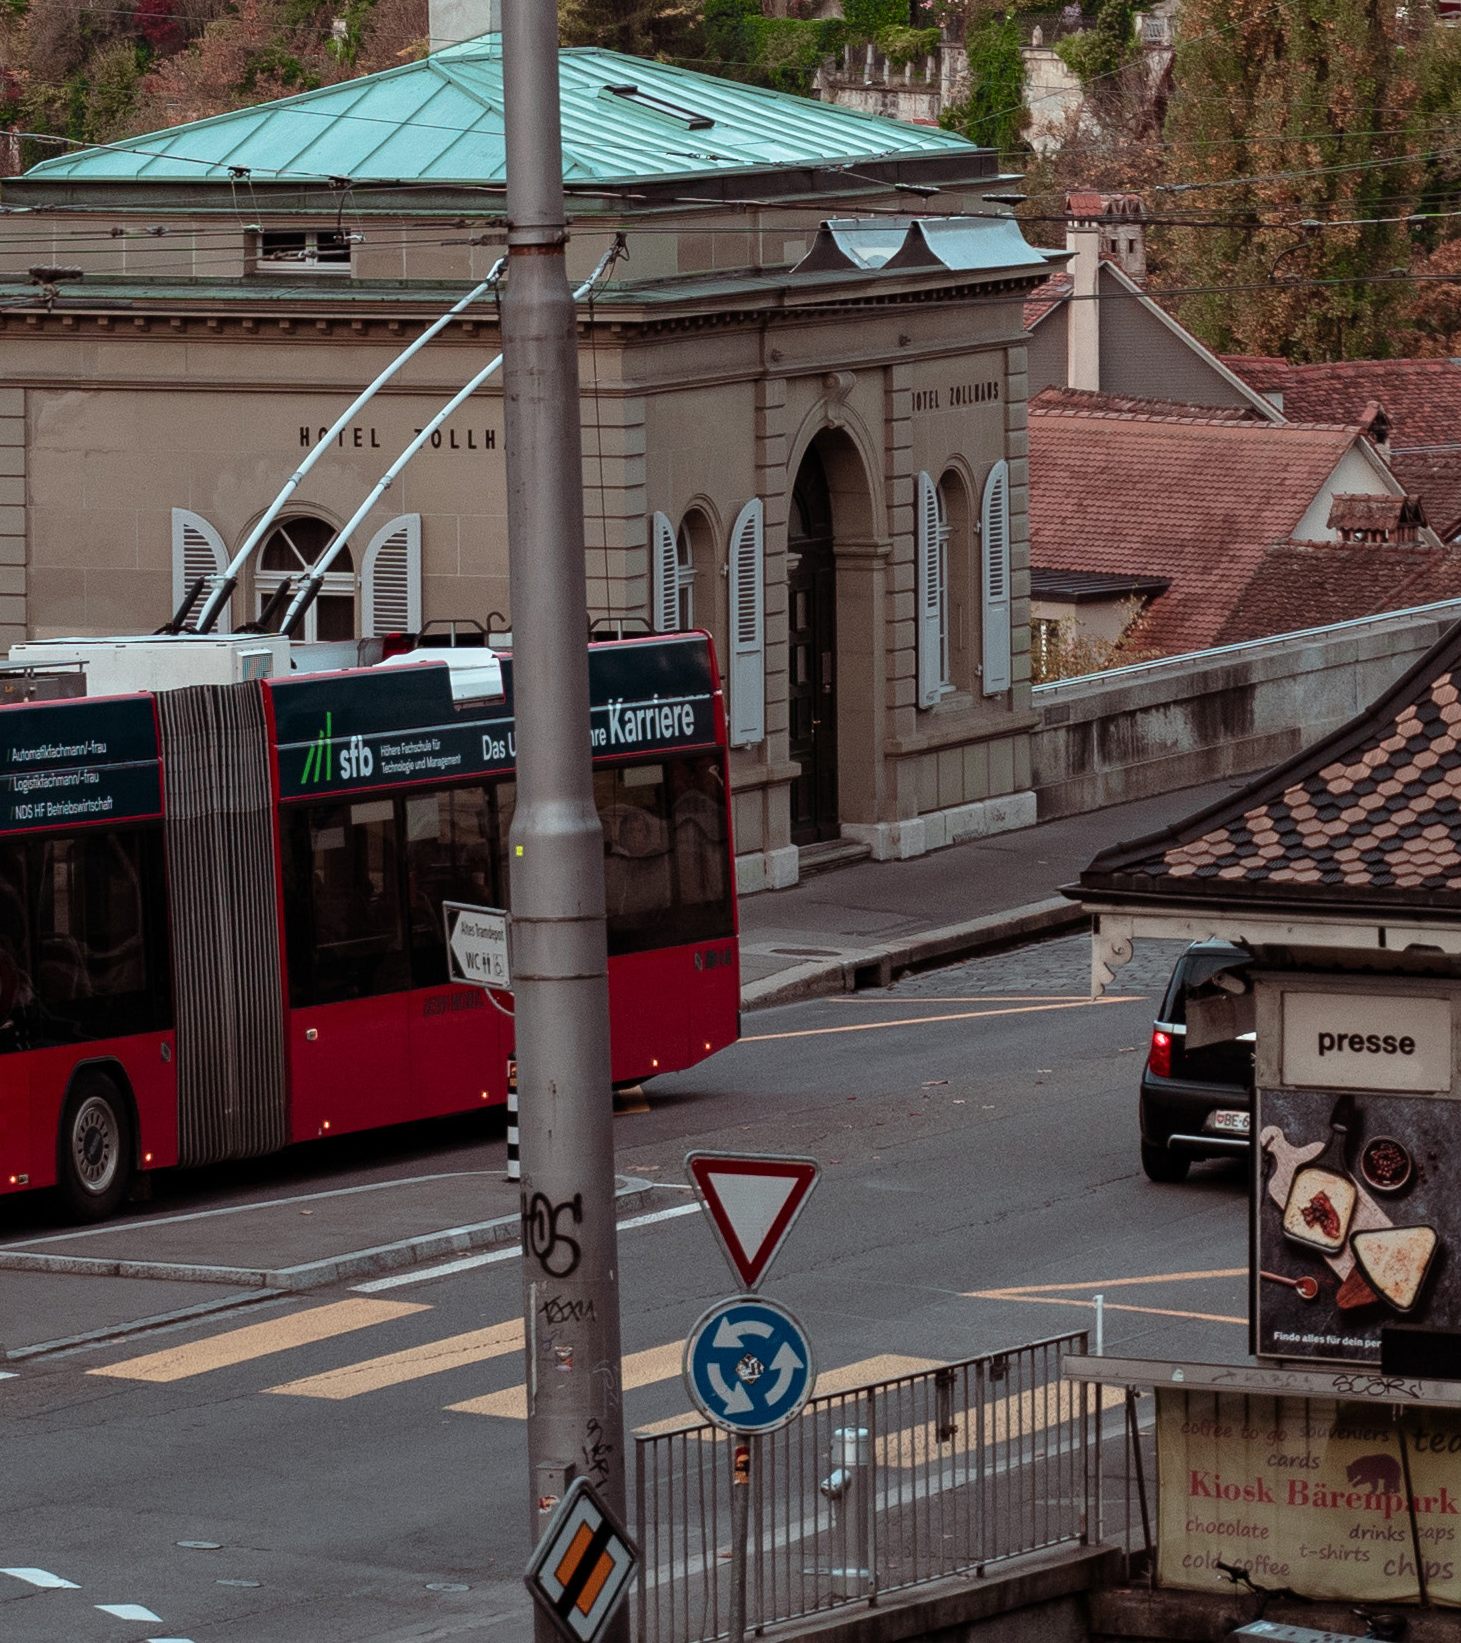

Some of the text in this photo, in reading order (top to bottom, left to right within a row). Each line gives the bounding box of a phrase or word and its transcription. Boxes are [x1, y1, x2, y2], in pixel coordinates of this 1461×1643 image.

[950, 381, 998, 406] ZOLLHAUS
[414, 428, 507, 449] ZOLLH
[608, 693, 695, 746] Karriere
[340, 735, 374, 780] sfb
[482, 734, 506, 761] Das
[415, 758, 426, 770] und
[15, 804, 34, 820] NDS
[34, 802, 46, 817] HF
[465, 951, 480, 971] WC
[1318, 1030, 1416, 1056] presse
[1273, 1331, 1301, 1343] Finde
[1301, 1332, 1325, 1344] alles
[1326, 1334, 1342, 1345] für
[1342, 1336, 1363, 1347] dein
[1181, 1420, 1233, 1439] coffee
[1240, 1425, 1259, 1441] to
[1266, 1427, 1288, 1447] go
[1267, 1451, 1321, 1471] cards
[1189, 1468, 1276, 1504] Kiosk
[1185, 1516, 1271, 1540] chocolate
[1348, 1523, 1406, 1543] drinks
[1182, 1551, 1455, 1580] cold coffee chps
[1299, 1544, 1371, 1563] t-shirts
